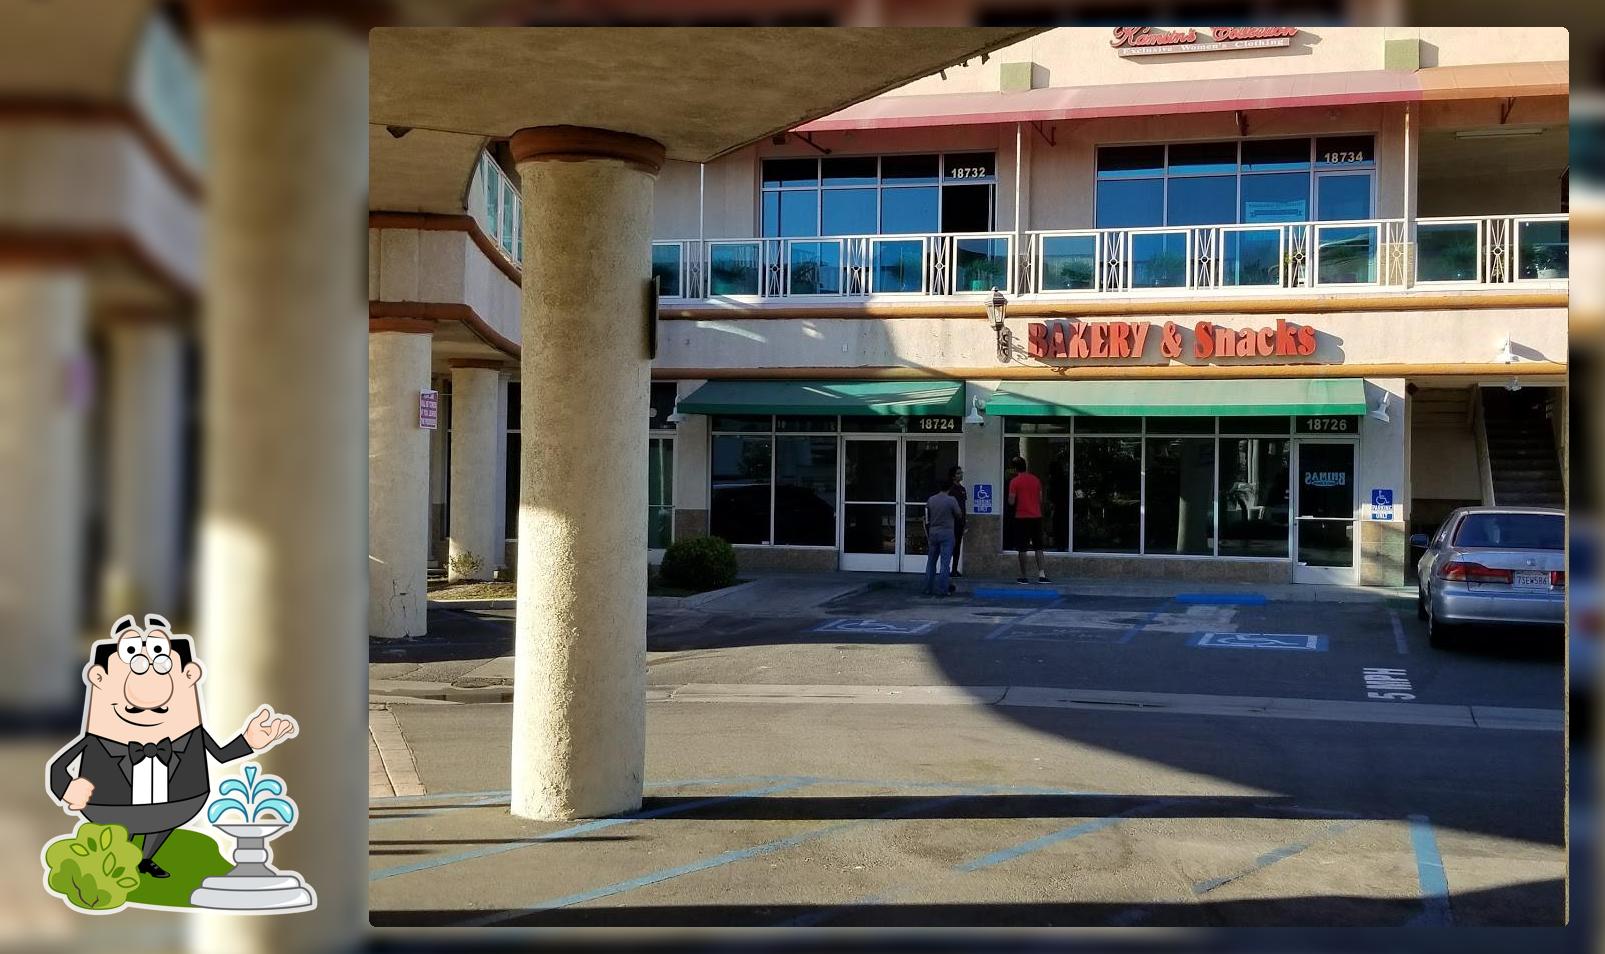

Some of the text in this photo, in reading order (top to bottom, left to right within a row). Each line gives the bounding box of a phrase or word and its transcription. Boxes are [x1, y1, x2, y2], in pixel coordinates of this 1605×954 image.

[1122, 38, 1285, 55] Exclusive Women's Clothing
[1324, 151, 1363, 164] 18734
[951, 166, 986, 179] 18732
[1027, 318, 1318, 359] BAKERY & Snacks
[919, 418, 955, 430] 18724
[1306, 418, 1348, 431] 18726
[1363, 667, 1416, 700] 5 MPH
